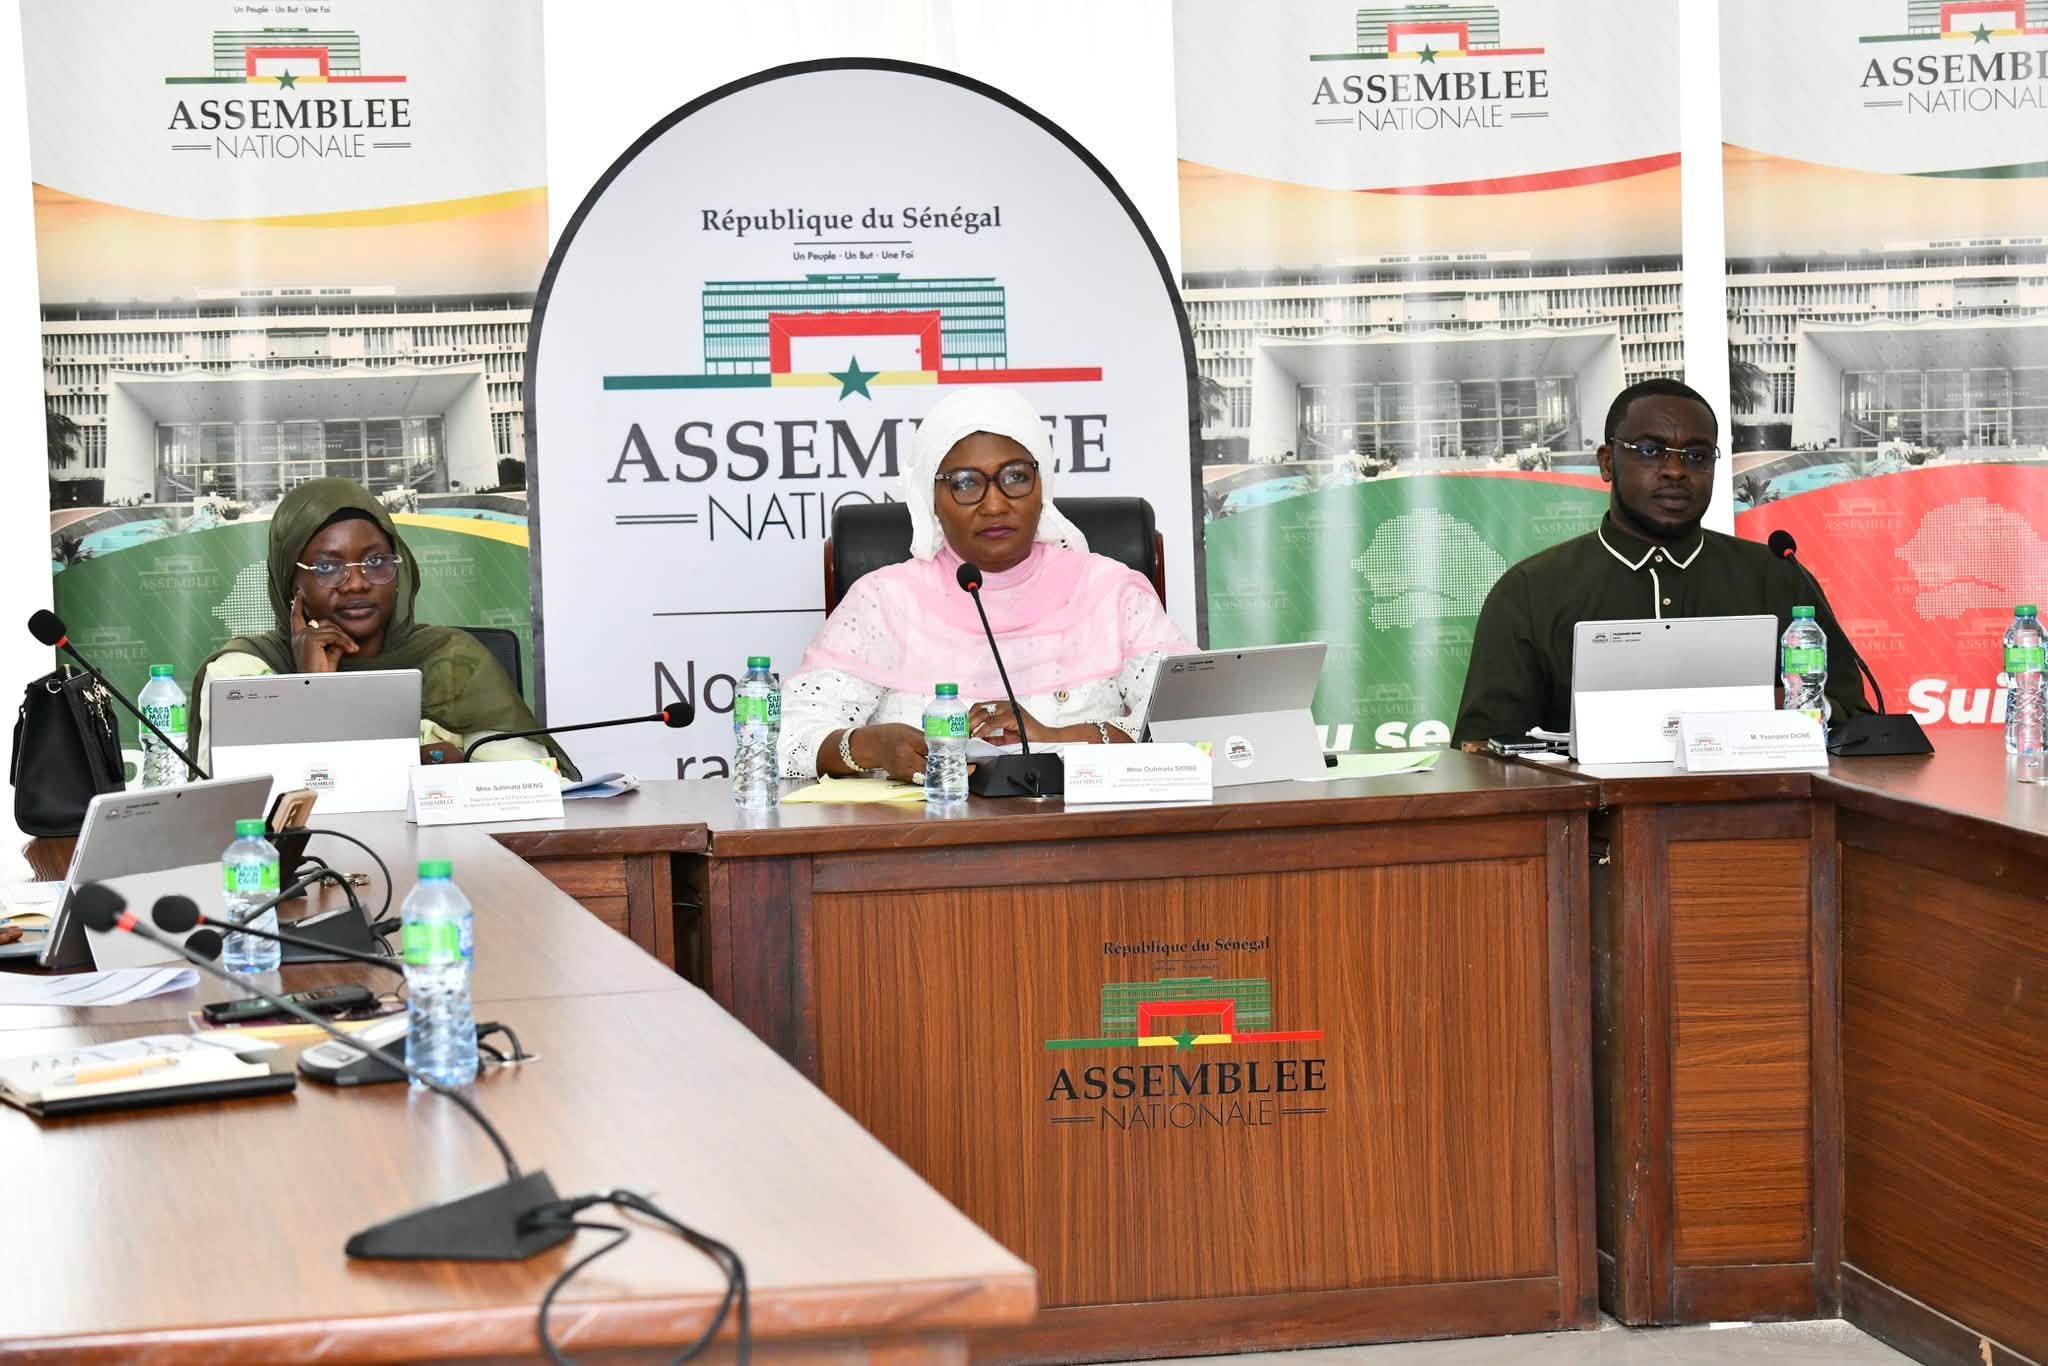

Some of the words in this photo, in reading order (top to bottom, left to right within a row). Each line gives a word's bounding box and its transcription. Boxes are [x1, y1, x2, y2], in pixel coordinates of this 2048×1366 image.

[1312, 70, 1549, 105] ASSEMBLEE
[168, 98, 411, 130] ASSEMBLEE
[1358, 105, 1504, 131] NATIONALE
[216, 134, 366, 159] NATIONALE
[701, 207, 854, 237] République
[862, 208, 895, 229] du
[902, 206, 1002, 234] Sénégal
[793, 251, 805, 261] Un
[808, 251, 836, 263] Peuple
[844, 250, 857, 261] Un
[860, 250, 873, 260] But
[882, 250, 899, 260] Une
[901, 250, 914, 259] Foi
[607, 413, 1111, 483] ASSEME
[1103, 937, 1188, 958] République
[1192, 938, 1211, 952] du
[1215, 935, 1271, 953] Sénégal
[1045, 1058, 1327, 1101] ASSEMBLEE
[1101, 1099, 1273, 1131] NATIONALE
